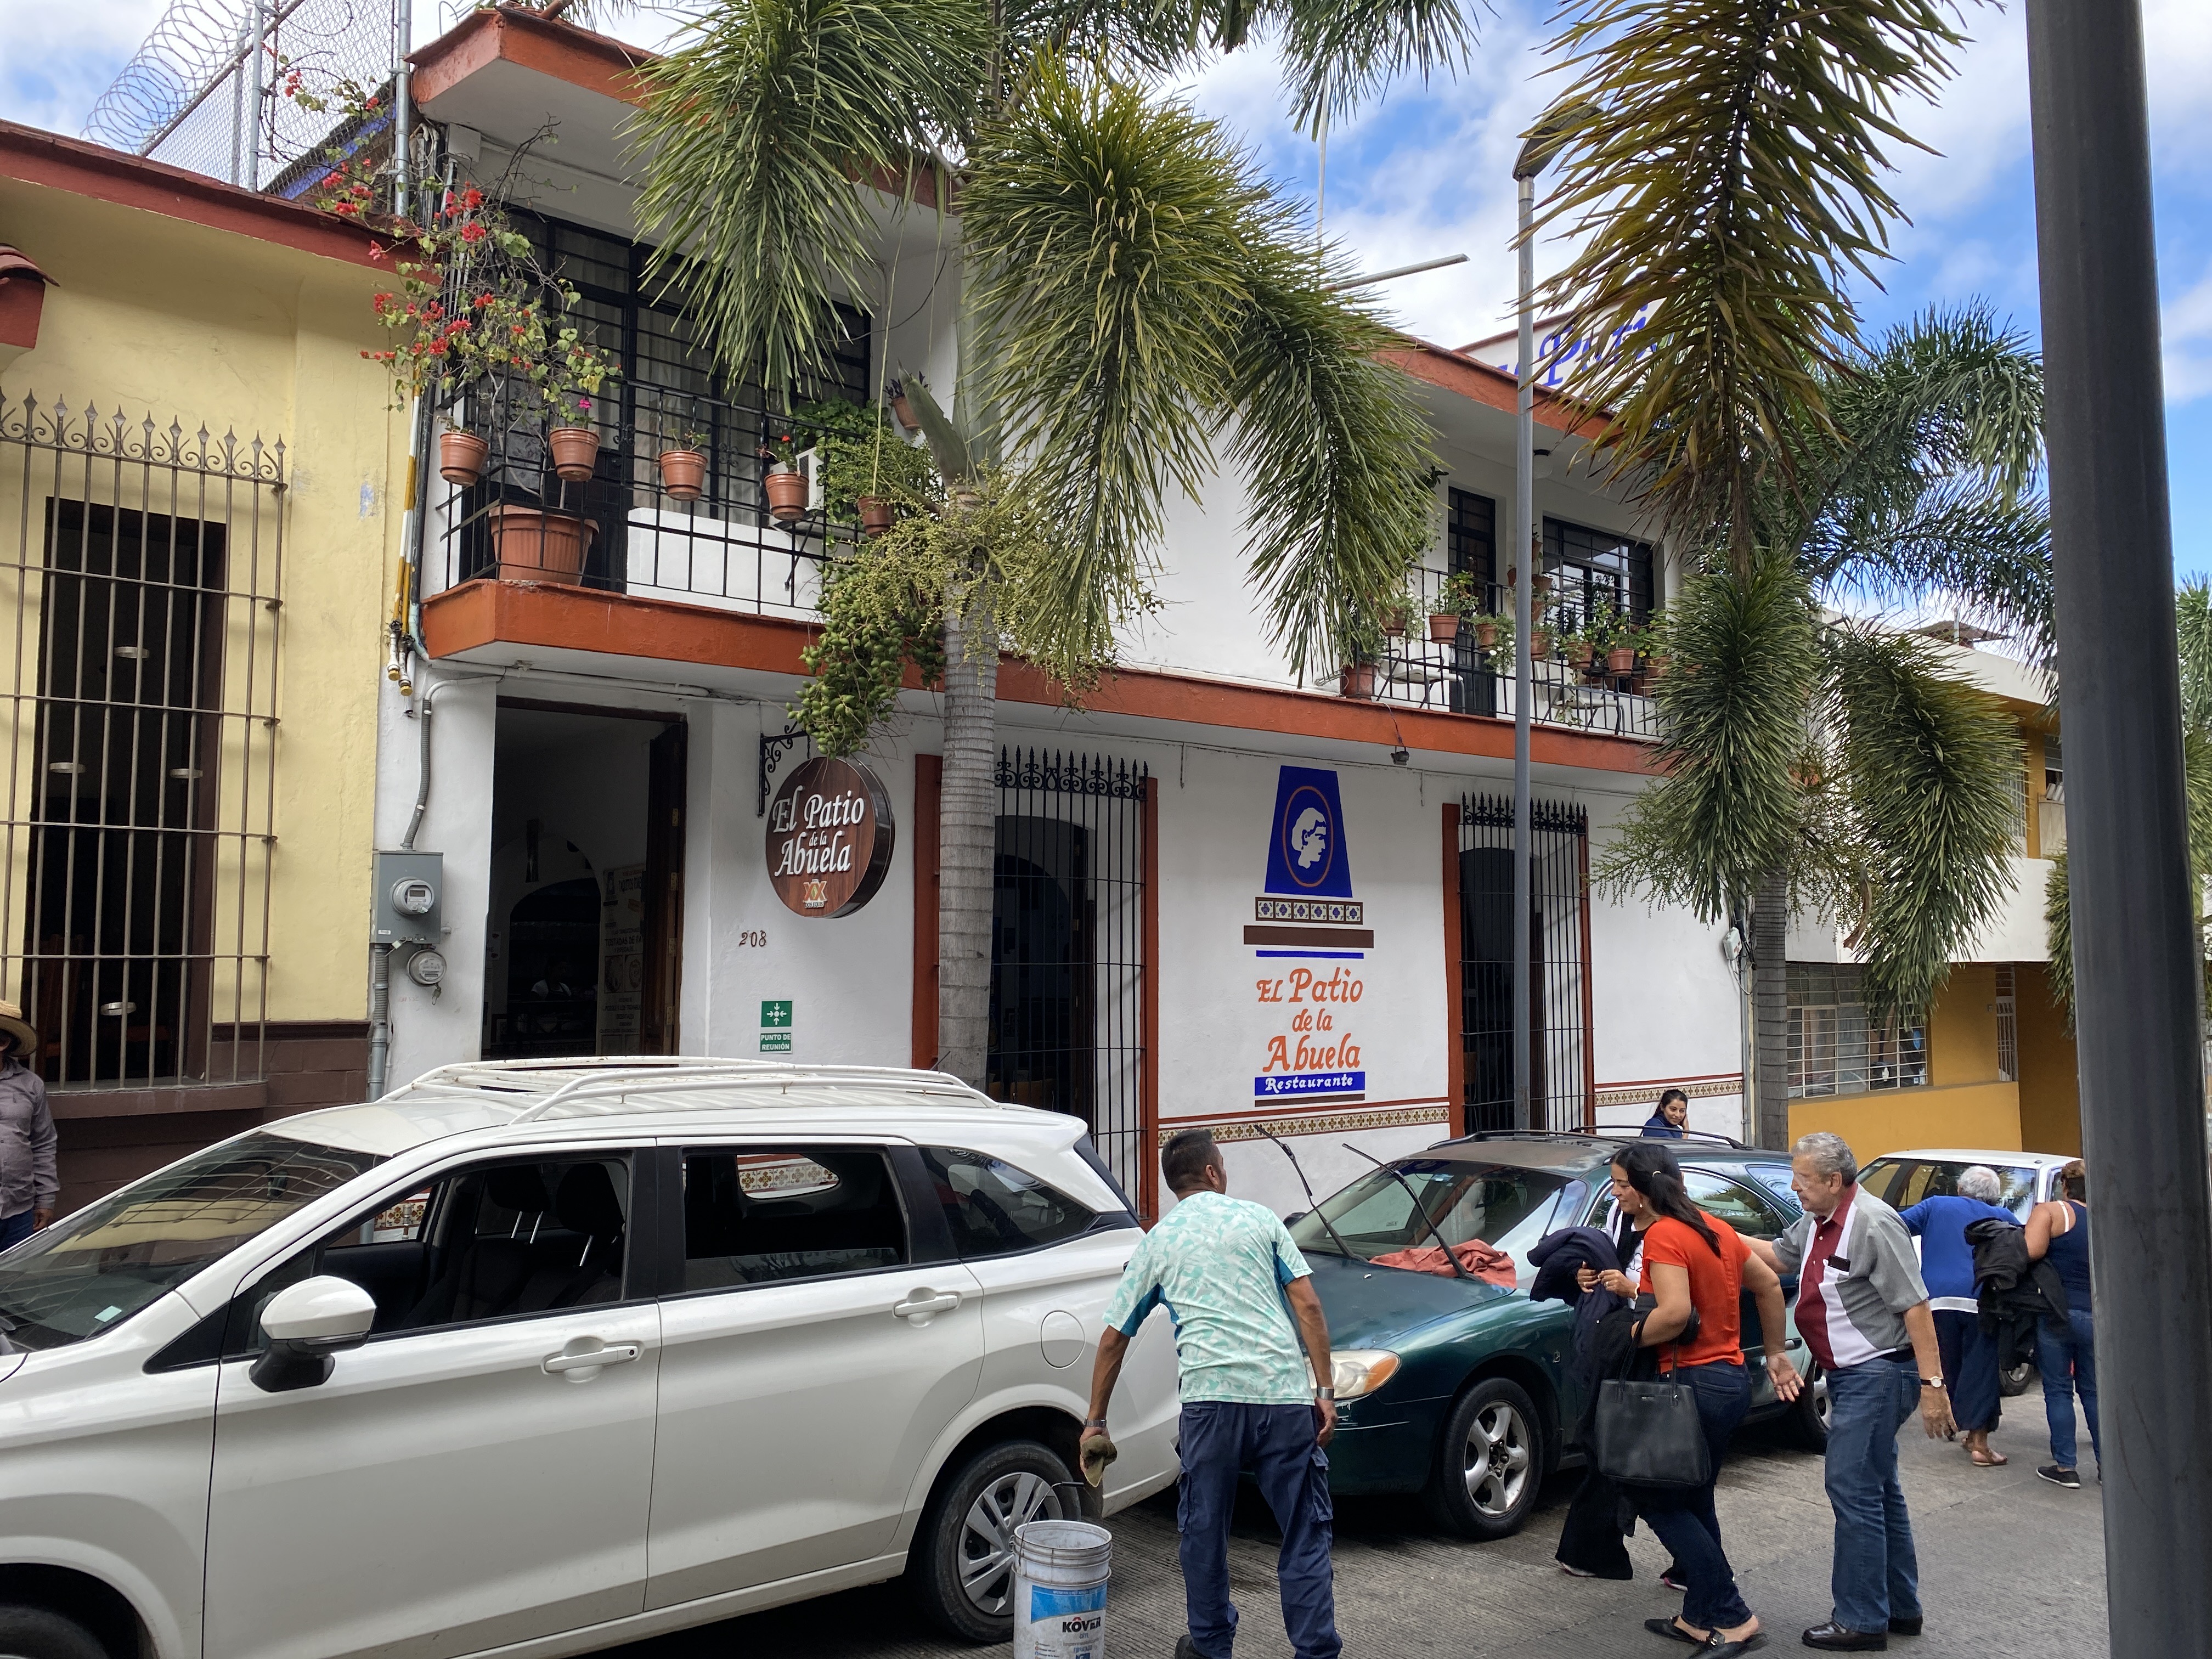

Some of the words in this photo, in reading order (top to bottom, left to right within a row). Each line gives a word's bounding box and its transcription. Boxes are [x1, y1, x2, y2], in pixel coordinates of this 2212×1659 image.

[772, 785, 803, 833] El
[804, 790, 865, 829] Patio
[809, 831, 817, 847] de
[820, 830, 827, 846] la
[774, 830, 851, 877] Abuela
[738, 930, 767, 948] 208
[1288, 967, 1363, 1003] Patio
[1292, 1008, 1314, 1032] de
[1317, 1008, 1333, 1032] la
[761, 1042, 789, 1050] REUNIÓN
[1262, 1033, 1362, 1072] Abuela
[1265, 1073, 1354, 1094] Restaurante
